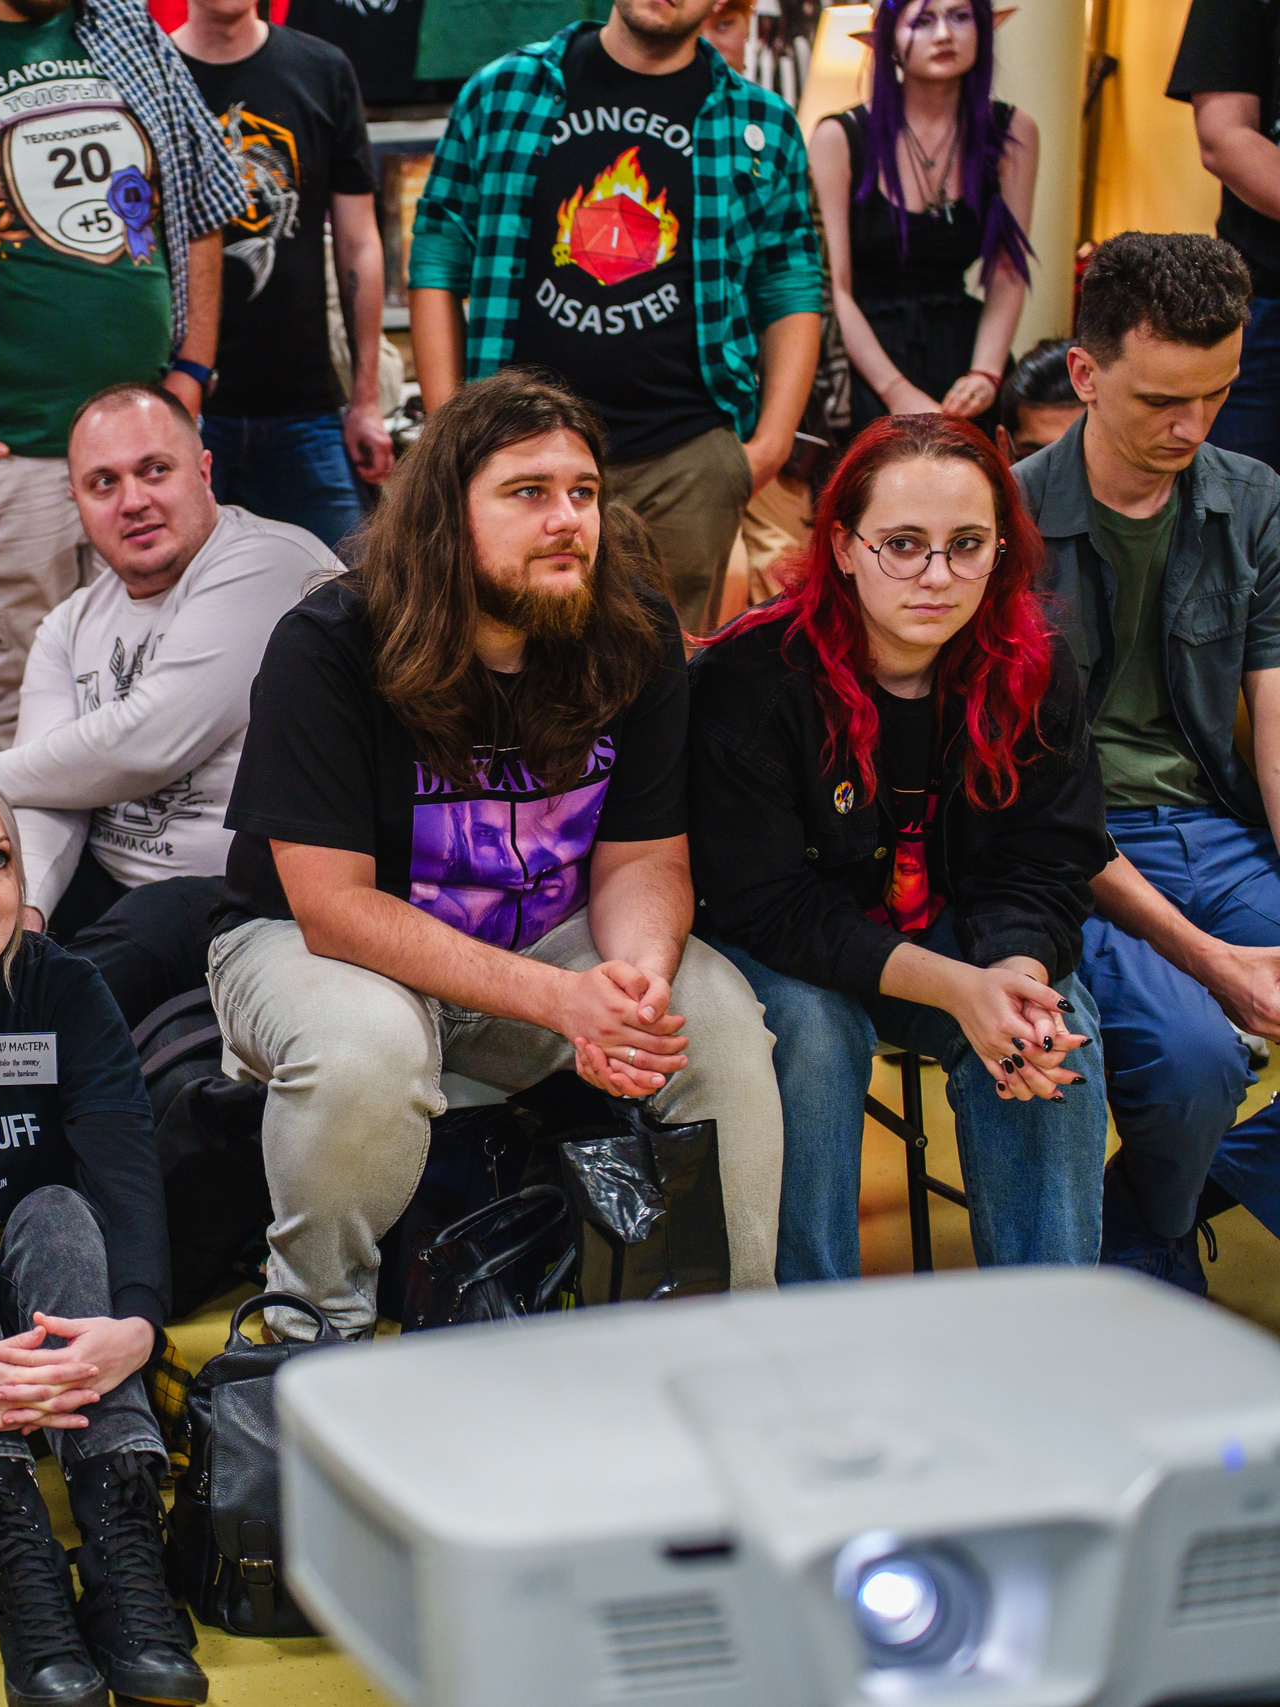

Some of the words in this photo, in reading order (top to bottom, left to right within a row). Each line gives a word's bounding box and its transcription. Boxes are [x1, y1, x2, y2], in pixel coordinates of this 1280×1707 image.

[4, 79, 113, 112] ТОЛСТЫЙ
[22, 121, 122, 144] ТЕЛОСЛОЖЕНИЕ
[551, 106, 694, 157] DUNGEO
[47, 142, 111, 189] 20
[78, 208, 113, 233] +5
[536, 278, 680, 335] DISASTER
[140, 839, 174, 856] CLUB
[9, 1041, 50, 1053] МАСТЕРА
